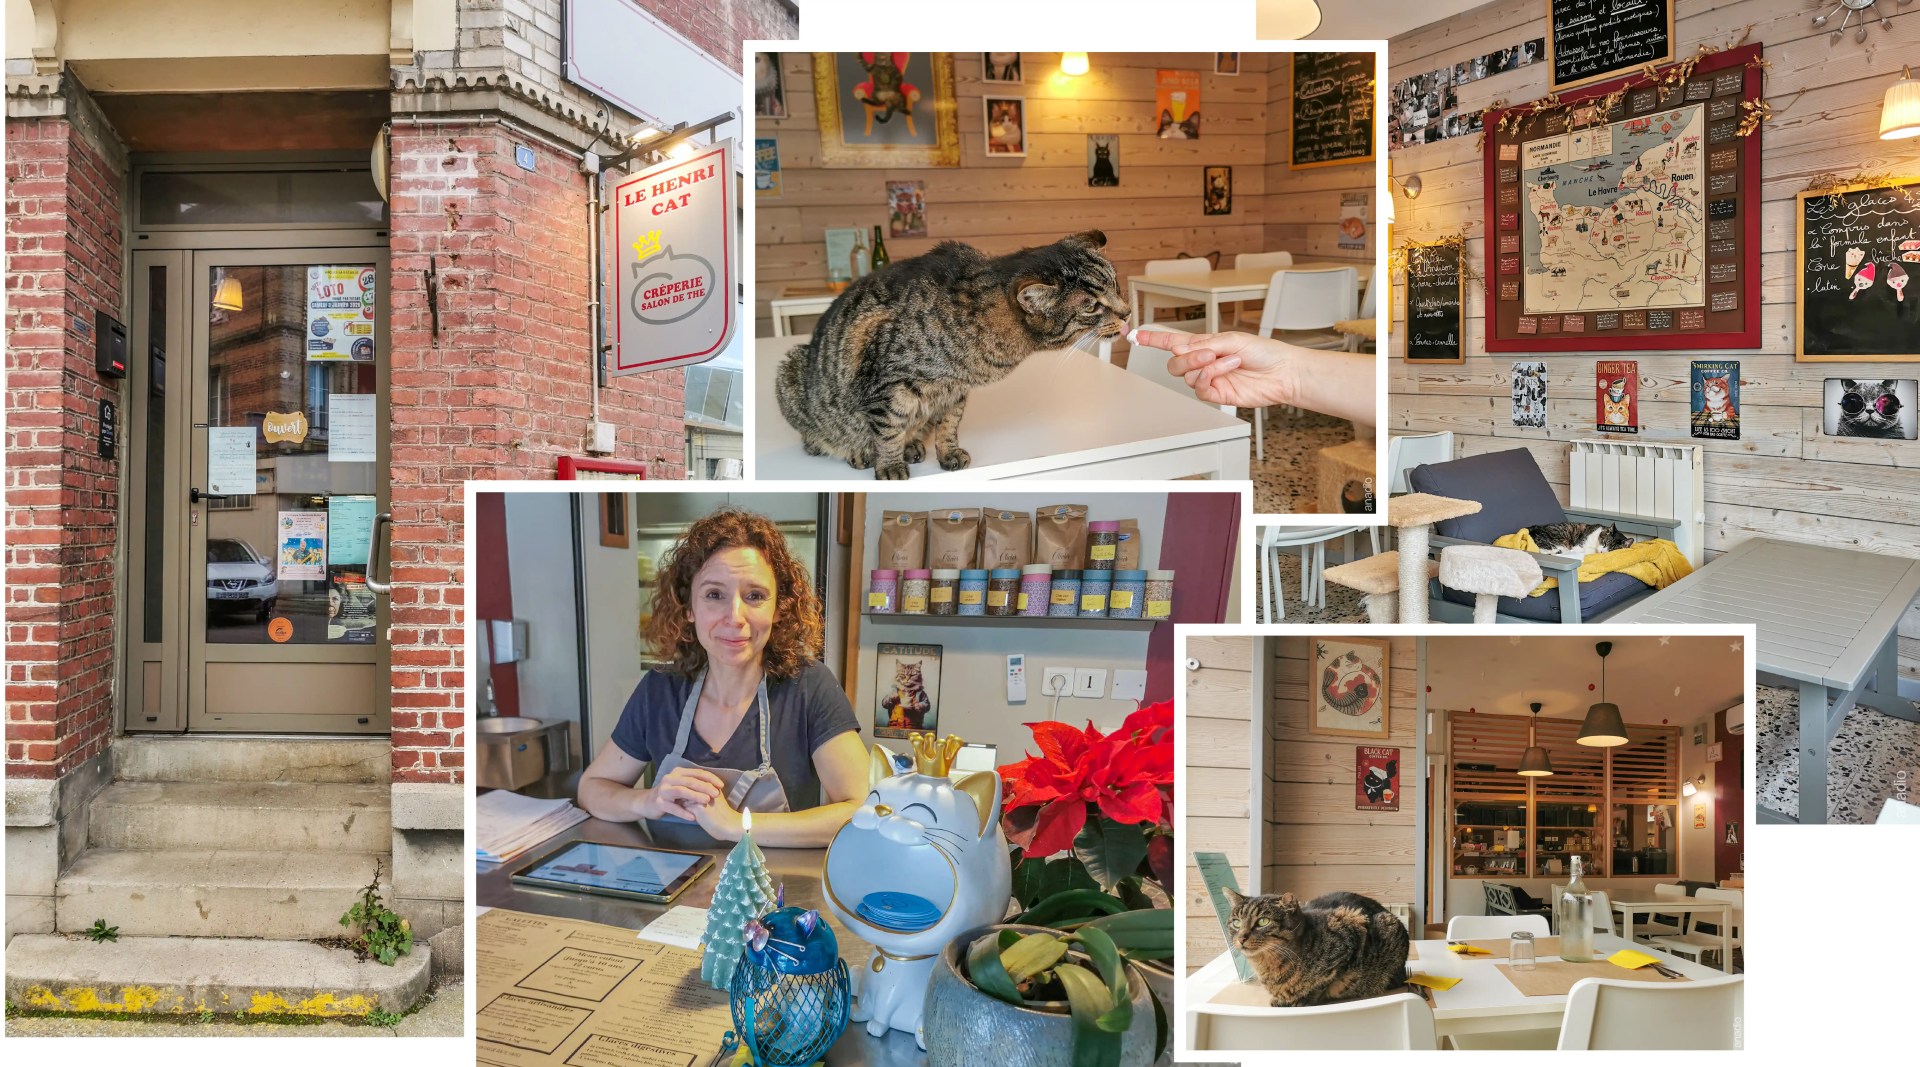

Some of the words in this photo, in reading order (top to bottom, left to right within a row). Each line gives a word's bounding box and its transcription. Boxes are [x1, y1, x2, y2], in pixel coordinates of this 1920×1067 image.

[1530, 140, 1562, 153] NORMANDIE
[624, 188, 646, 207] LE
[651, 164, 715, 198] HENRI
[1562, 176, 1594, 186] MANCHE
[1671, 173, 1693, 182] Rouen
[1598, 186, 1618, 195] Havre
[651, 193, 692, 216] CAT
[1842, 194, 1896, 226] glaces
[1820, 223, 1870, 241] Compris
[1877, 217, 1908, 228] dans
[1872, 248, 1902, 263] bûche
[362, 274, 374, 286] 28
[643, 276, 703, 300] CRÊPERIE
[1811, 277, 1840, 293] lutin
[316, 283, 344, 299] LOTO
[641, 296, 672, 310] SALON
[674, 294, 686, 304] DE
[687, 288, 706, 300] THE
[1598, 363, 1620, 374] GINGER
[1623, 363, 1636, 373] TEA
[267, 419, 303, 436] Ouvert
[882, 647, 937, 655] CATITUDE
[652, 981, 697, 992] gourmandes
[500, 993, 526, 1003] Glaces
[528, 1000, 574, 1012] artisanales
[598, 1036, 628, 1046] Glaces
[631, 1042, 676, 1056] digestives
